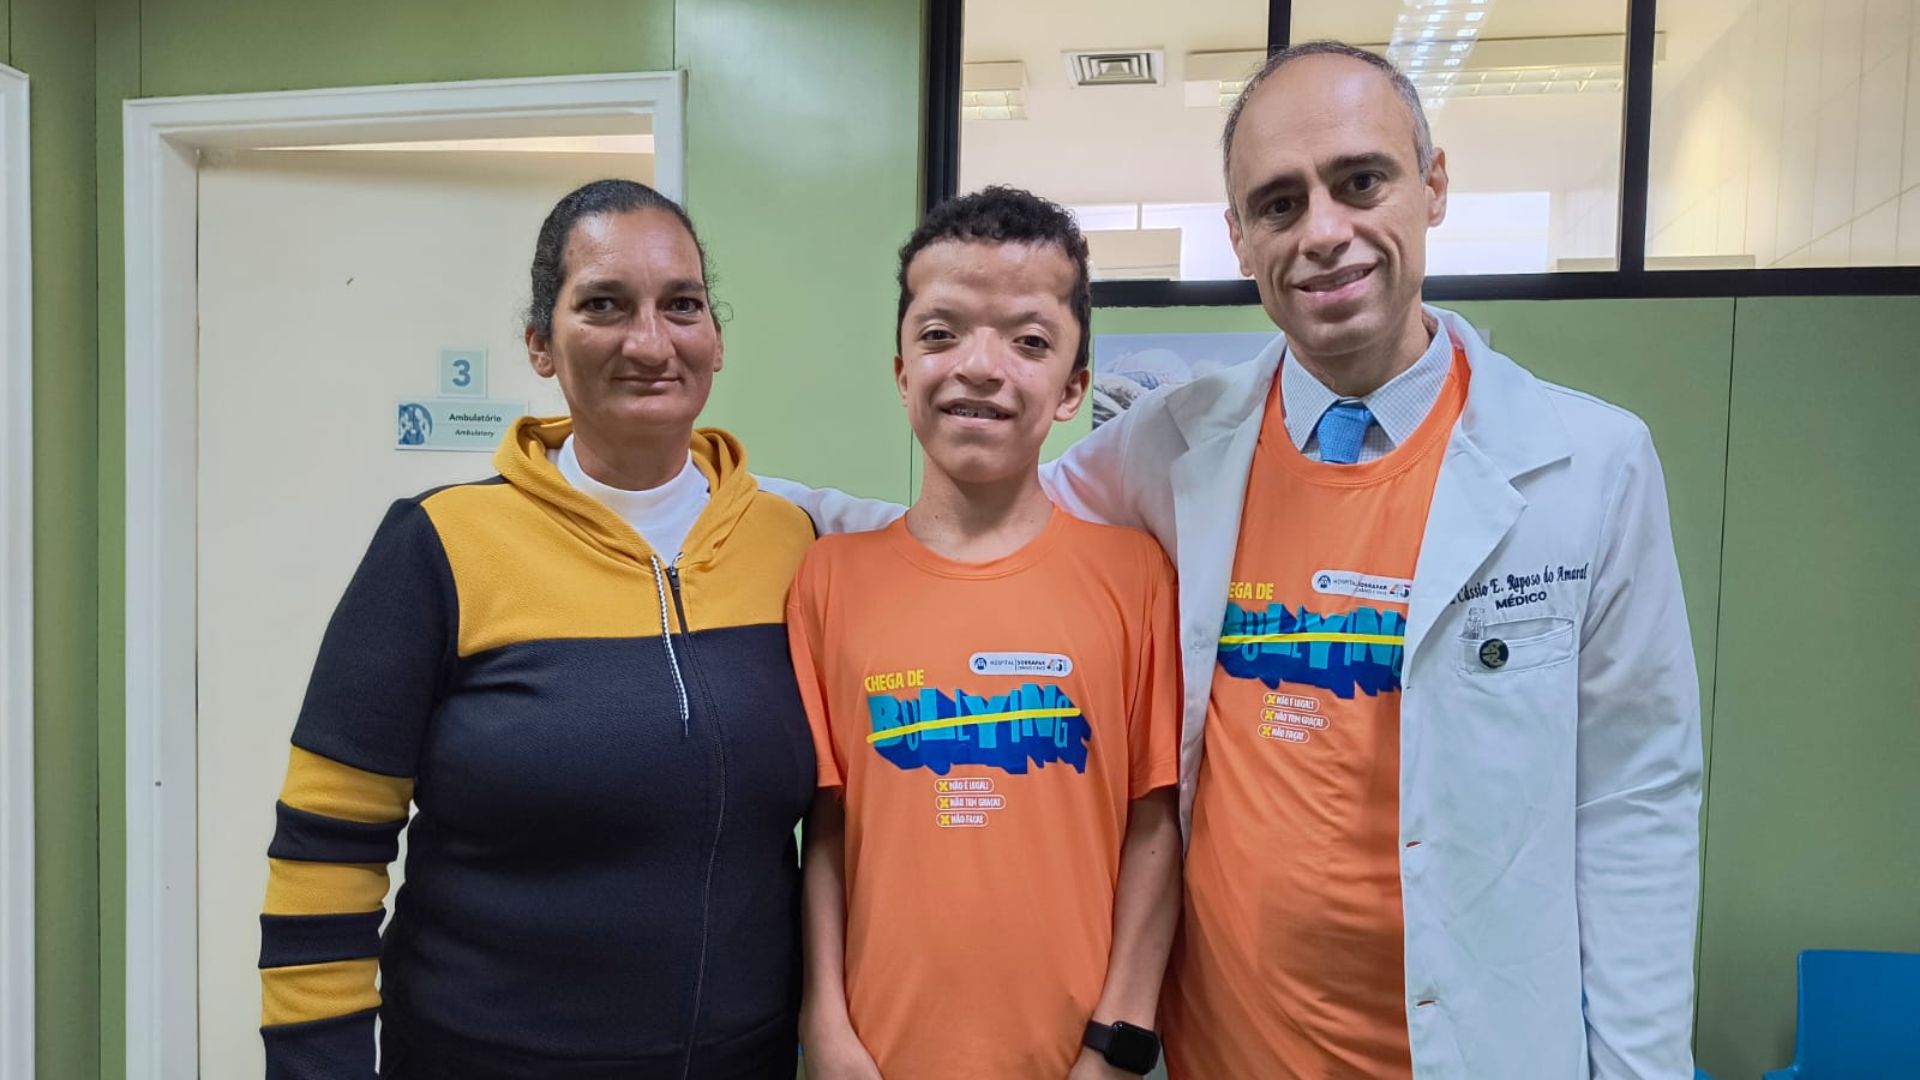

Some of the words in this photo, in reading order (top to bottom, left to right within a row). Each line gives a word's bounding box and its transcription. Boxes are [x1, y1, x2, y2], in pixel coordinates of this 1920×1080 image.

[452, 359, 471, 387] 3
[448, 412, 502, 423] Ambulatório
[455, 428, 495, 438] Ambulatory
[1507, 573, 1541, 594] Raposo
[1543, 565, 1554, 583] do
[1556, 562, 1589, 582] Amaral
[1255, 582, 1274, 600] DE
[1495, 591, 1547, 610] MÉDICO
[864, 672, 905, 692] CHEGA
[907, 669, 924, 687] DE
[867, 683, 1073, 752] BULLYING
